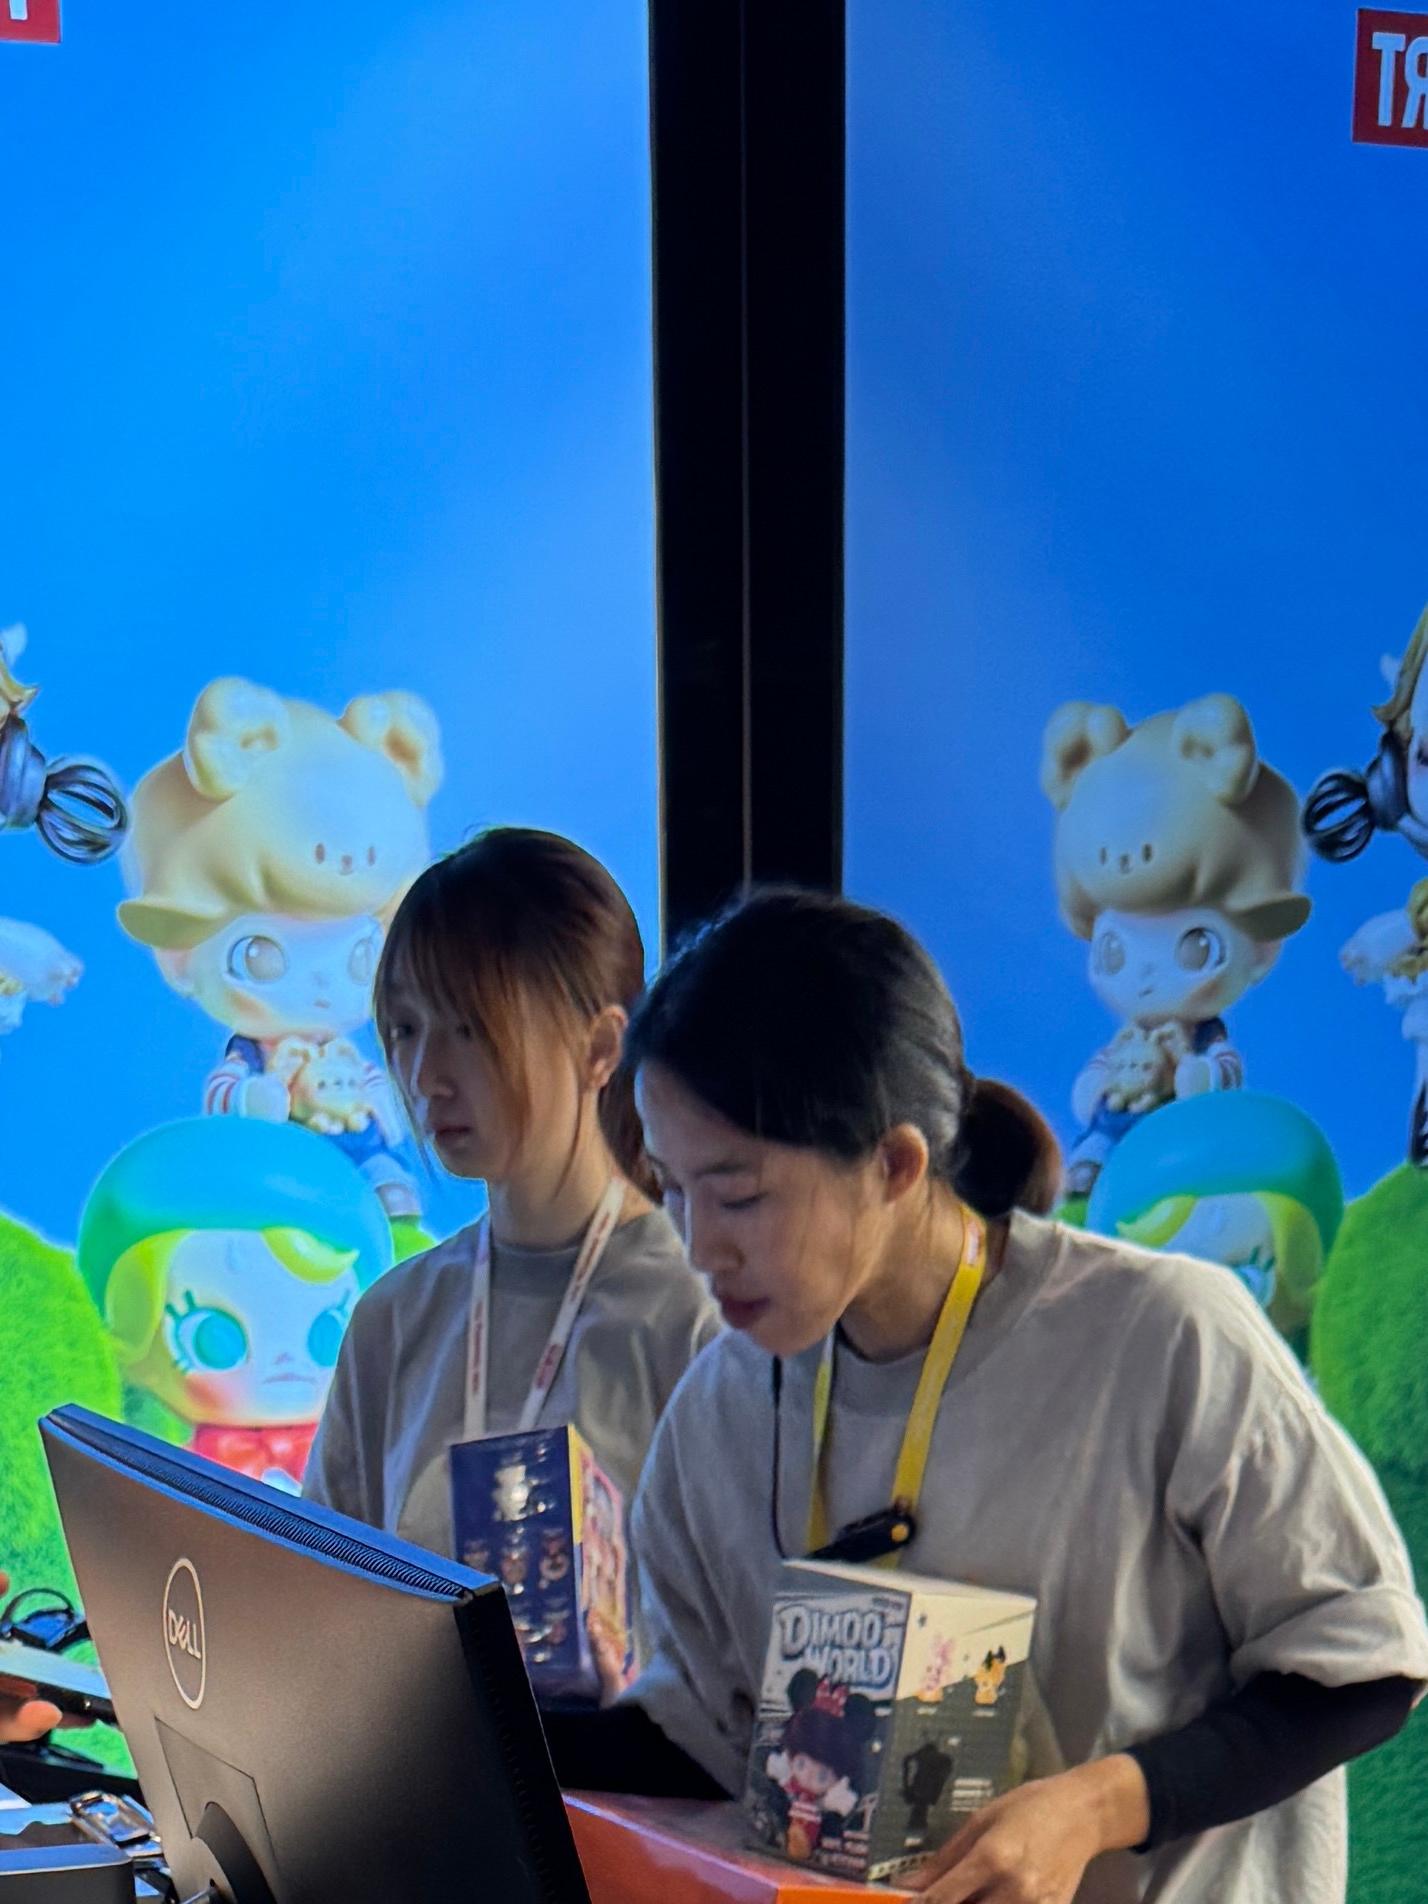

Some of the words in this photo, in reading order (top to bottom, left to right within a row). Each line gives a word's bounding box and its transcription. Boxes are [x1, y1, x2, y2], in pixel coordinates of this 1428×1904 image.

[167, 1608, 202, 1660] DELL
[779, 1604, 884, 1660] DIMOO
[804, 1643, 892, 1686] WORLD
